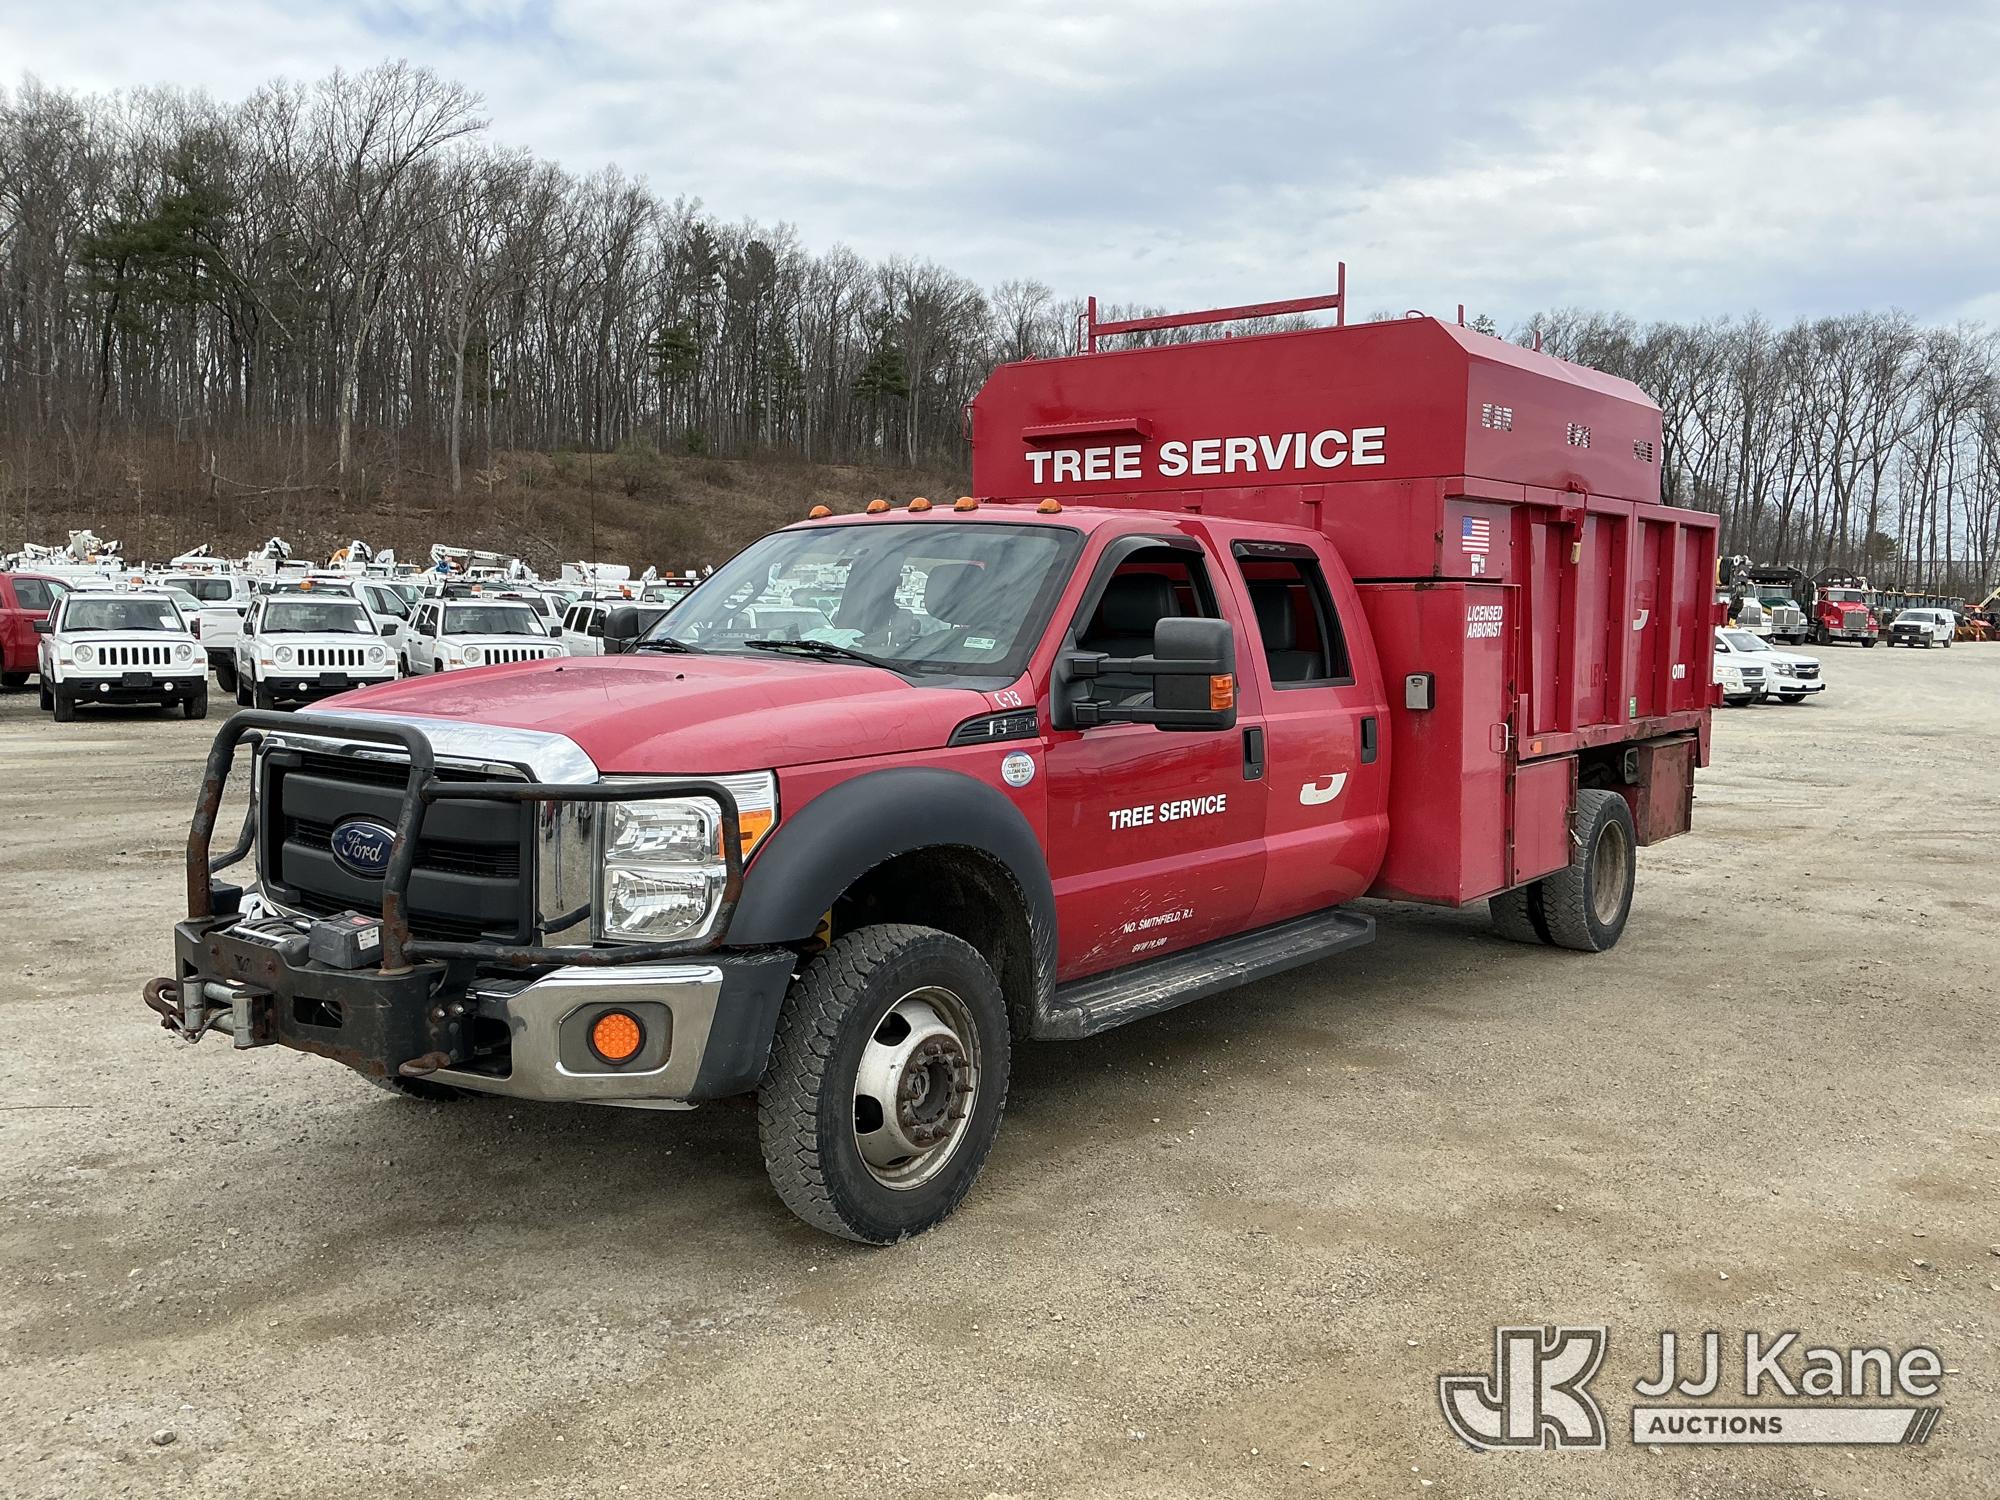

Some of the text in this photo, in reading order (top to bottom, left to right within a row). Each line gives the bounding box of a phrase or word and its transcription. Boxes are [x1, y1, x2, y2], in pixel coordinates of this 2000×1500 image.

[1025, 426, 1386, 484] TREE SERVICE
[1467, 605, 1503, 622] LICENSED
[1466, 621, 1503, 639] ARBORIST
[1109, 793, 1228, 831] TREE SERVICE
[342, 829, 383, 862] Ford
[1123, 921, 1137, 934] NO.
[1138, 911, 1181, 931] SMITHFIELD,
